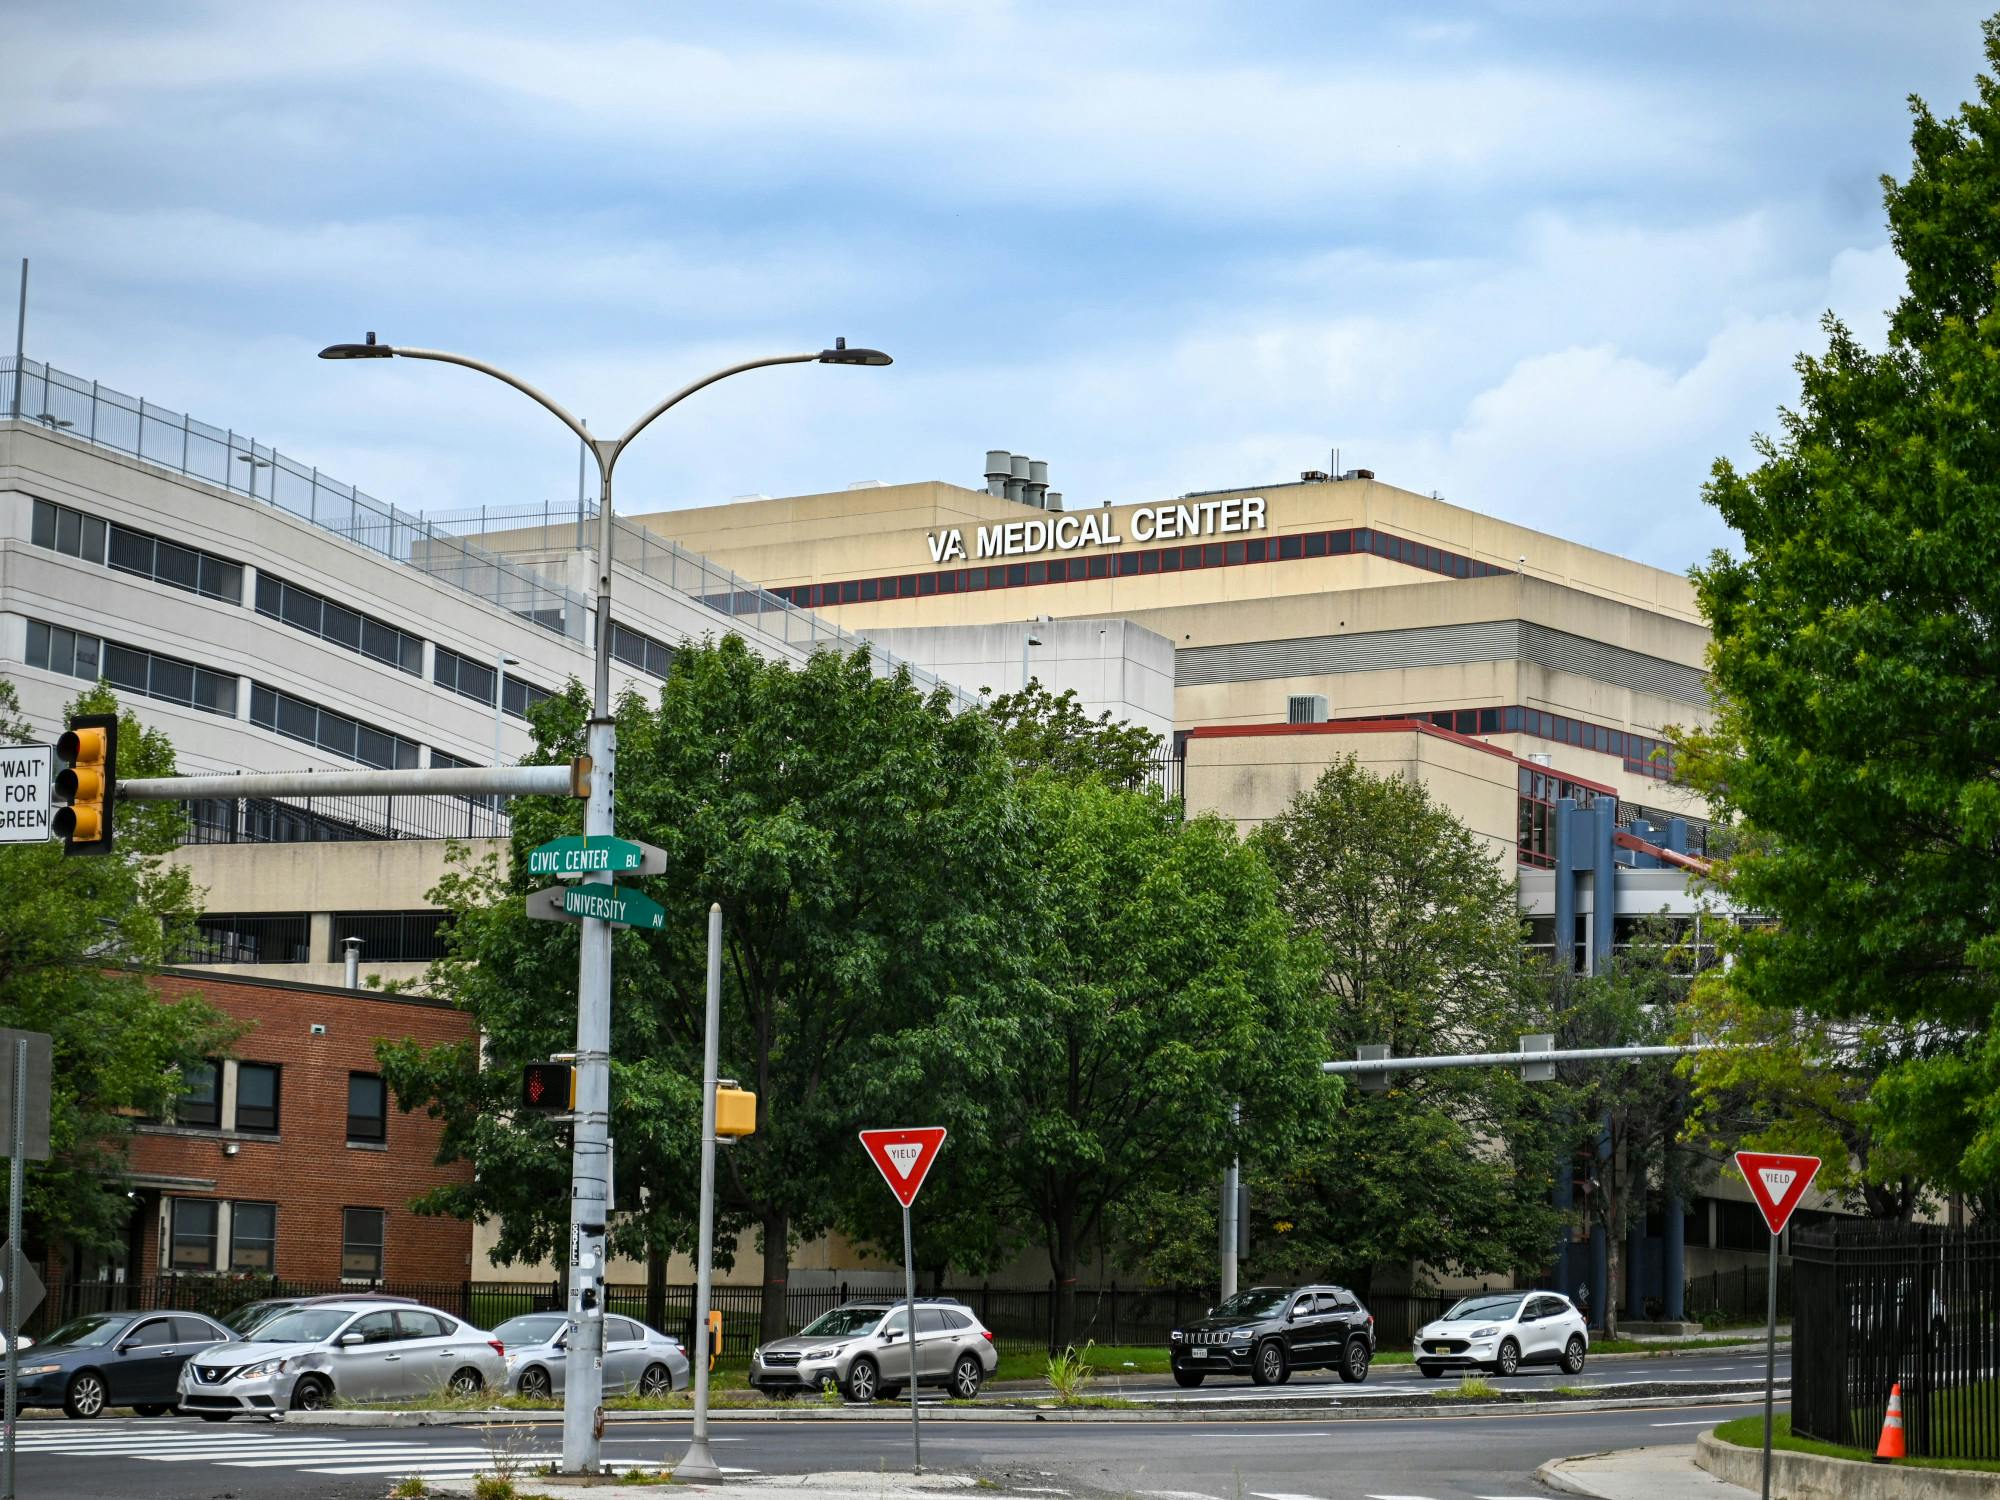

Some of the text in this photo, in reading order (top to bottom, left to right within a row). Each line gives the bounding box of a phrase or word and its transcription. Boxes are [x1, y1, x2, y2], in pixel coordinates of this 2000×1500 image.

[927, 497, 1265, 562] VA MEDICAL CENTER
[2, 759, 41, 778] WAIT
[5, 784, 37, 803] FOR
[530, 849, 639, 871] CIVIC CENTER BL
[566, 891, 664, 928] UNIVERSITY AV
[891, 1148, 917, 1159] YIELD
[1765, 1172, 1790, 1184] YIELD
